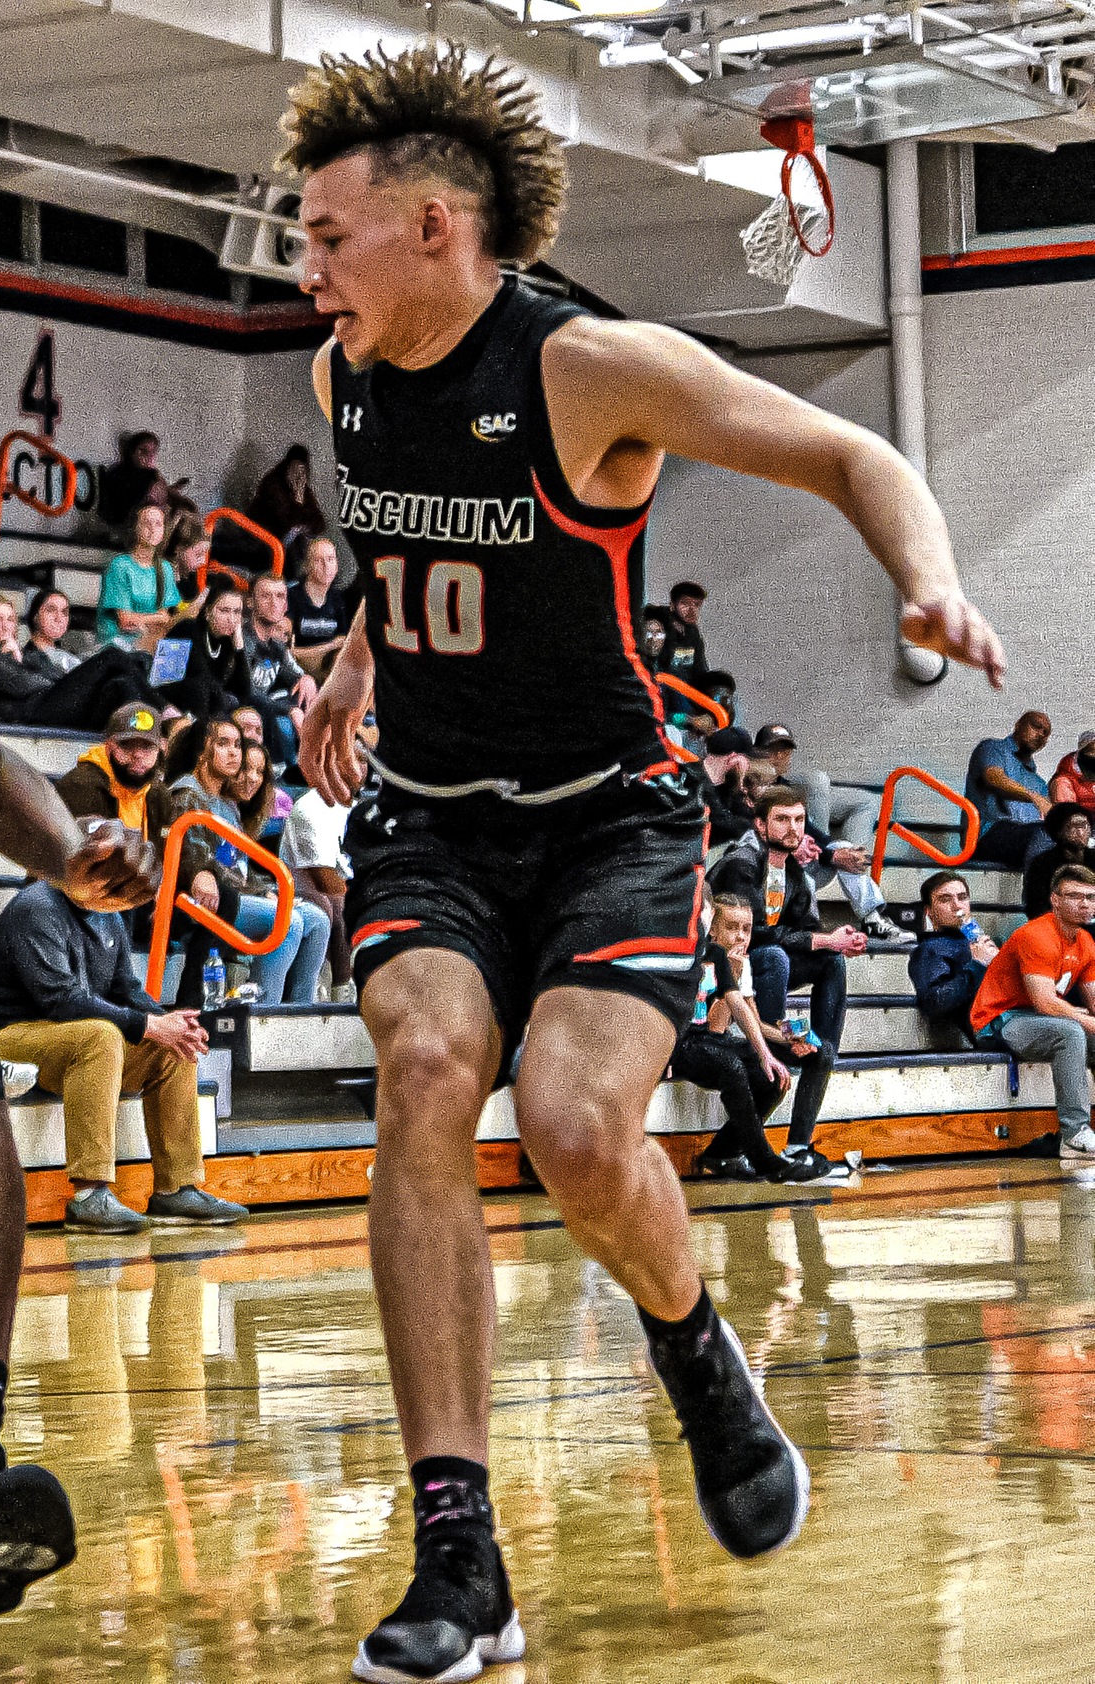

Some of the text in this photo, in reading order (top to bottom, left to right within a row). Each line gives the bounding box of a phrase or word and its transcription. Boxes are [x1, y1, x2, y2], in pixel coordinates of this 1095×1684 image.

[19, 329, 63, 442] 4
[478, 411, 517, 434] SAC
[373, 554, 486, 656] 10
